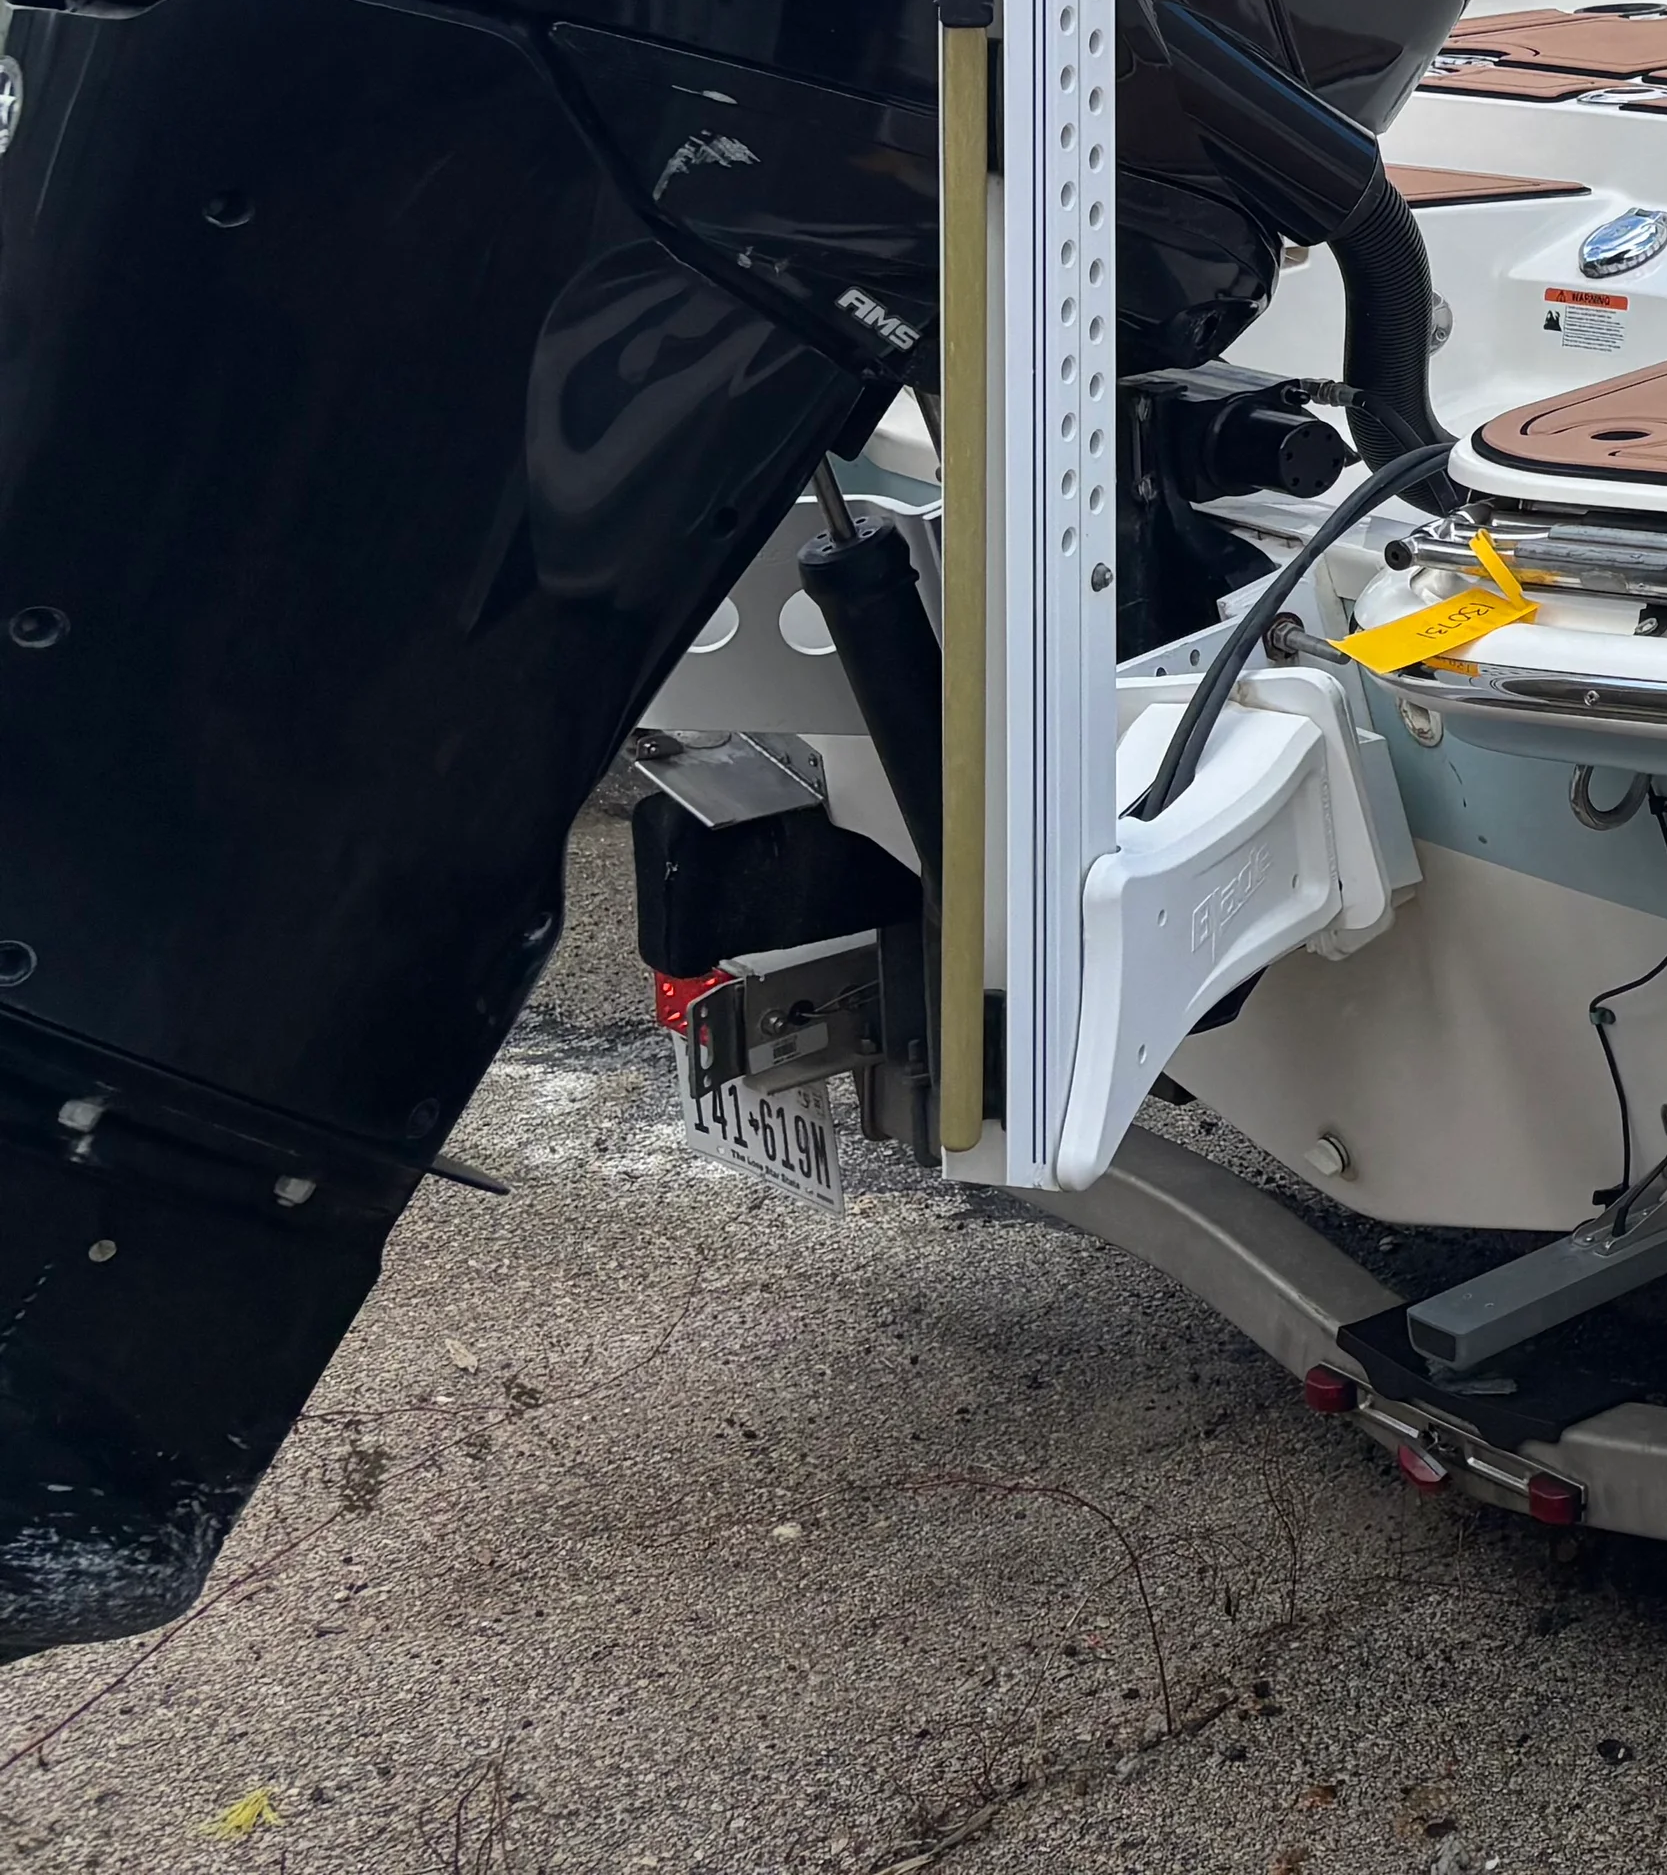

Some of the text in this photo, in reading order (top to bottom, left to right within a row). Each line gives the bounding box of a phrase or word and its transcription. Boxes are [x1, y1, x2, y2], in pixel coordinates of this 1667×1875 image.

[1572, 291, 1611, 306] WARNING
[837, 289, 921, 350] AMS
[1416, 602, 1496, 640] 130731
